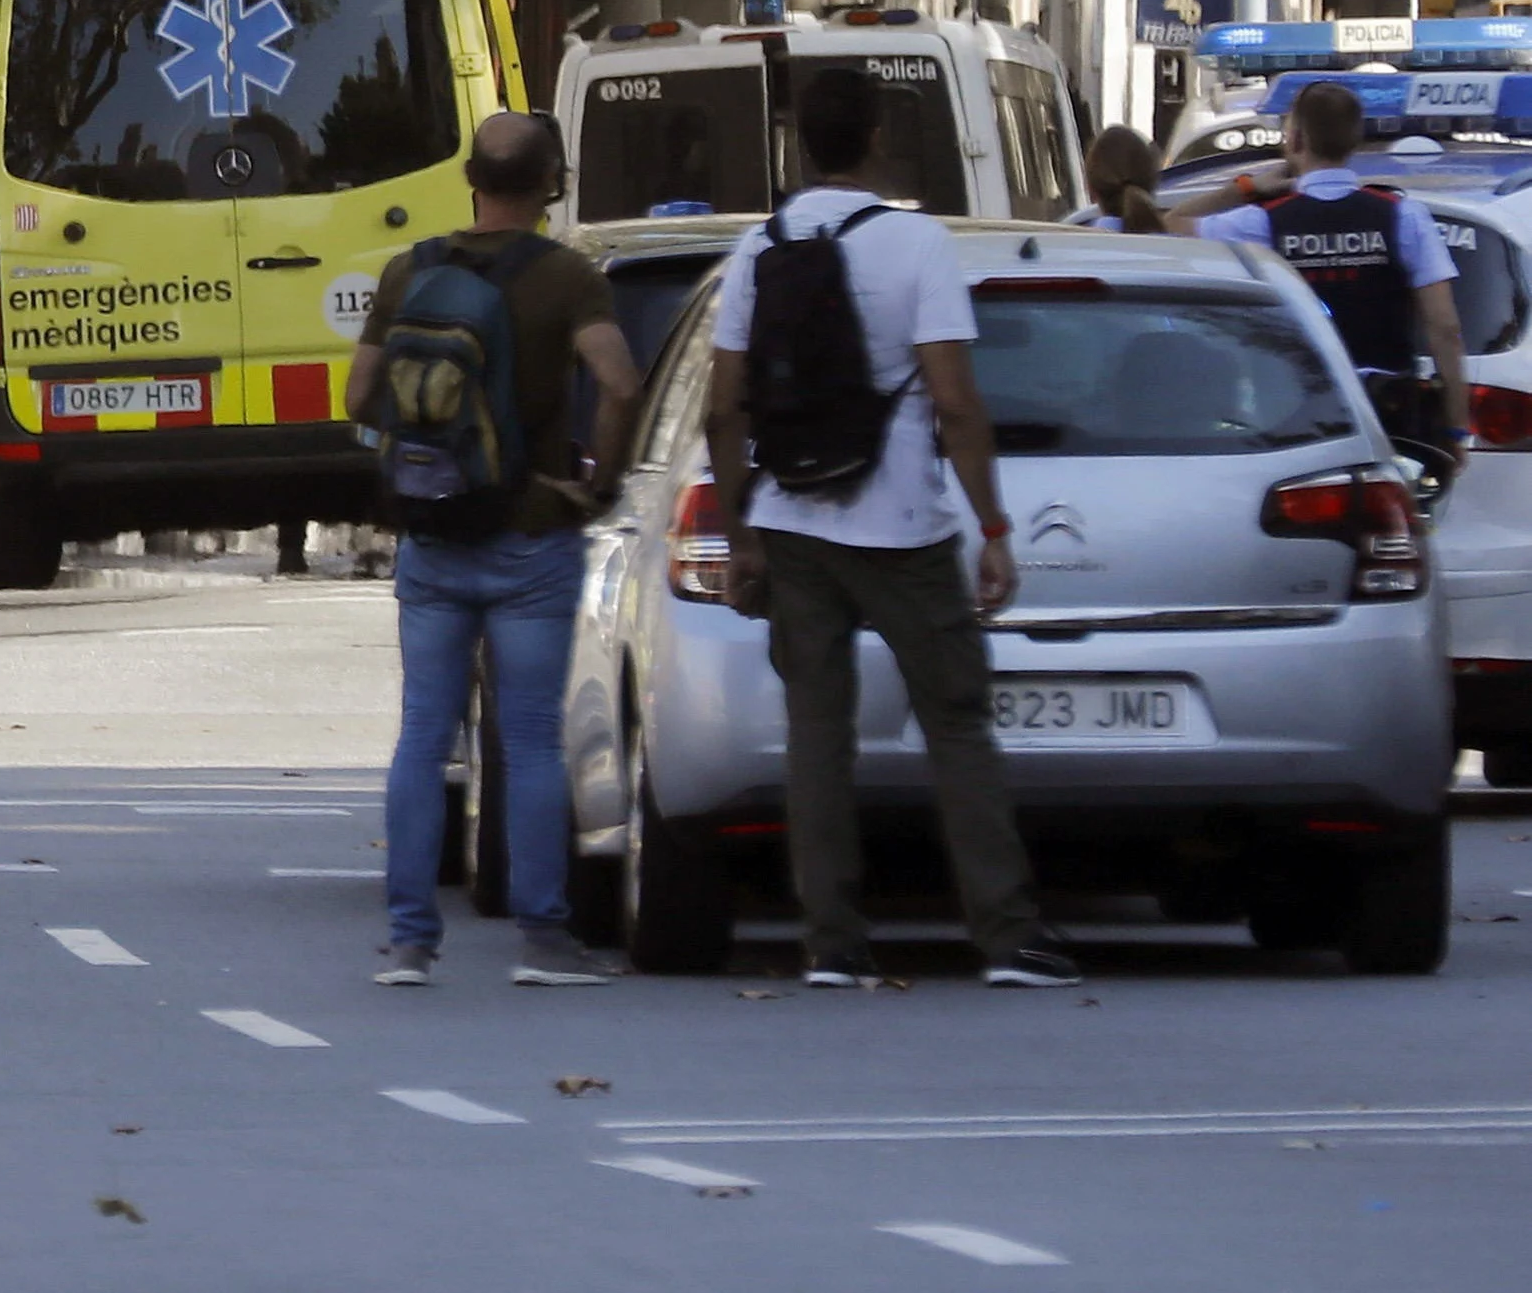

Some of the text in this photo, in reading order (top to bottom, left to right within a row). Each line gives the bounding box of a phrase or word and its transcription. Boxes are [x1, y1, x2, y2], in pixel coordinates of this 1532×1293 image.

[1344, 22, 1406, 44] POLICIA
[1416, 80, 1491, 108] POLICIA
[1284, 231, 1387, 256] POLICIA
[9, 275, 233, 314] emergències
[11, 317, 180, 352] mèdiques
[70, 383, 196, 410] 0867 HTR
[1094, 691, 1176, 728] JMD
